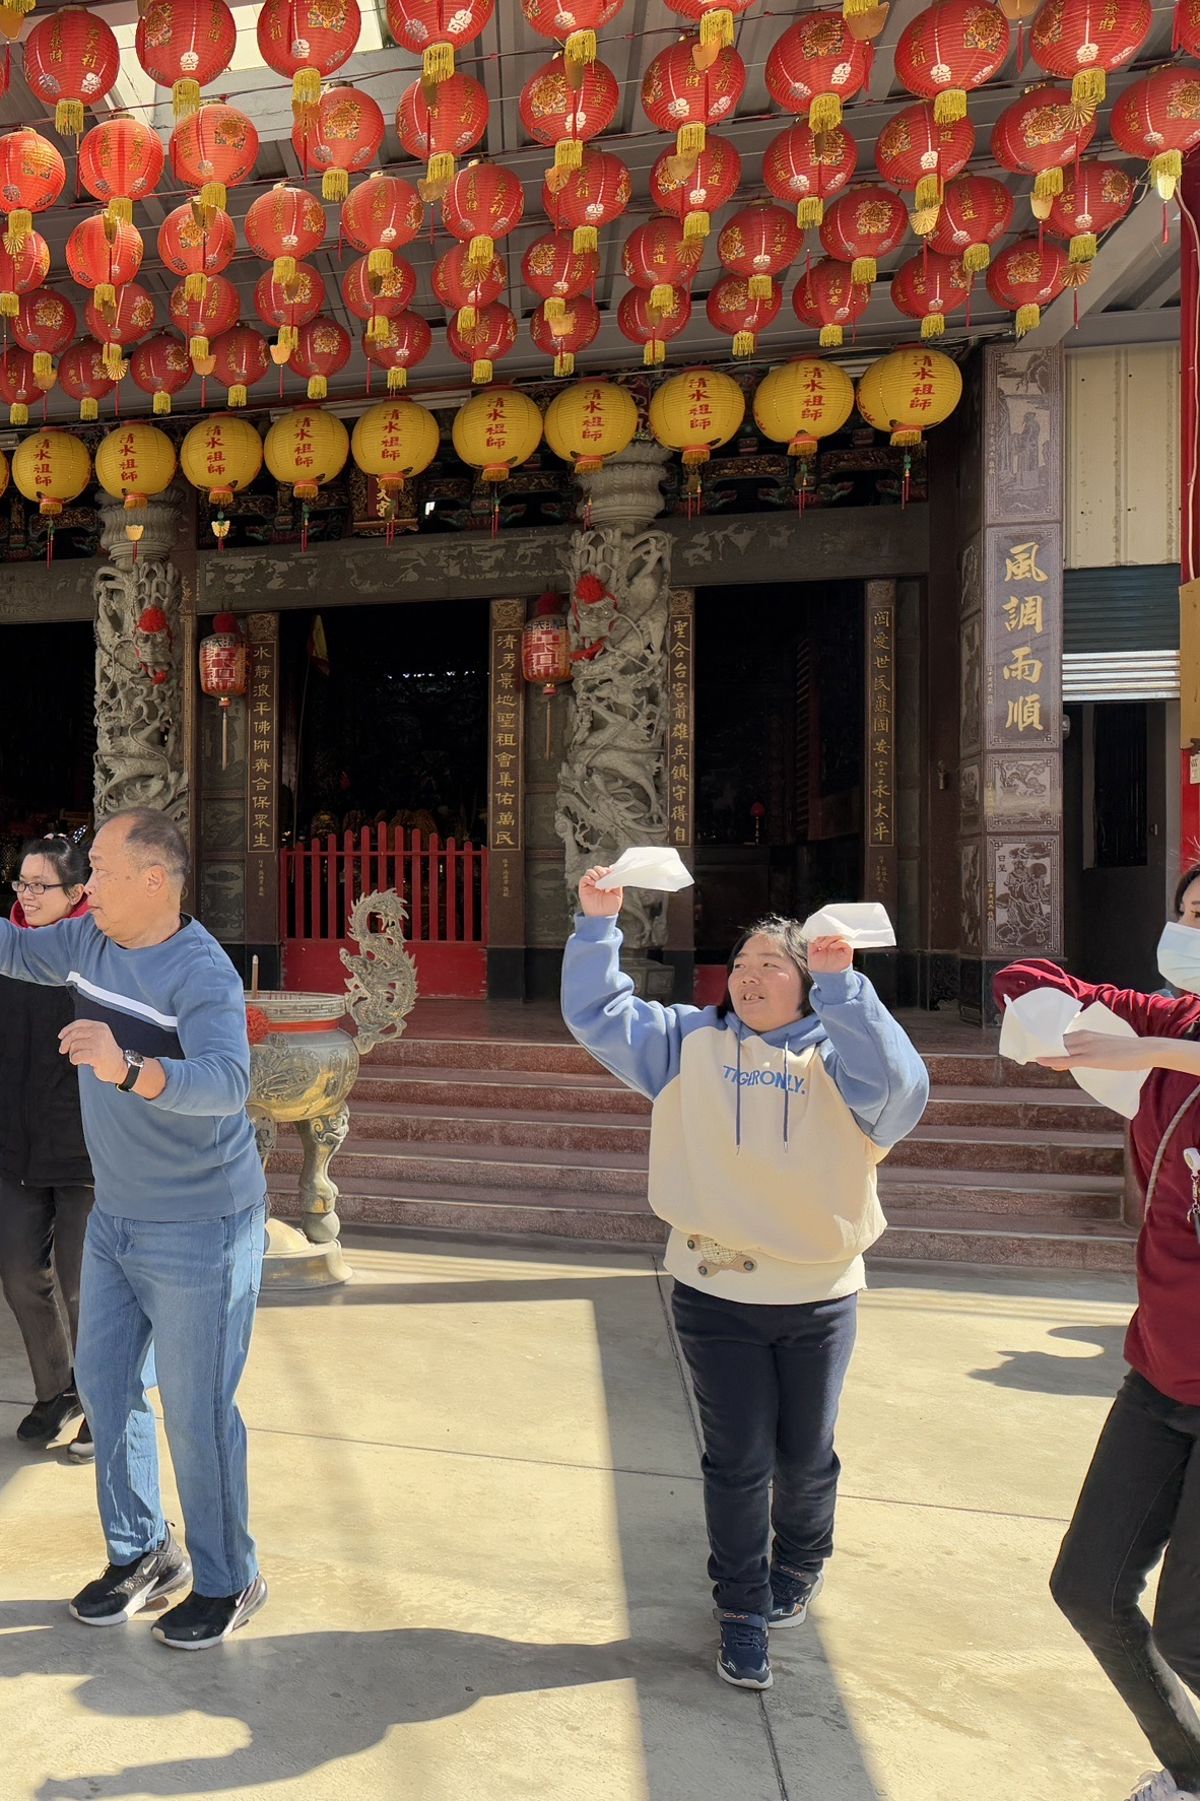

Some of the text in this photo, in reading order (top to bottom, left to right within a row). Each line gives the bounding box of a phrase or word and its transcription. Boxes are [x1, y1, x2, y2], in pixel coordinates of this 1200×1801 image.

[688, 377, 712, 430] 清水祖師
[801, 367, 825, 421] 清水祖師
[910, 355, 935, 410] 清水祖師
[381, 409, 402, 461] 清水祖師
[486, 397, 508, 449] 清水祖師
[582, 389, 605, 442] 清水祖師
[33, 439, 53, 487] 清水祖師
[119, 433, 139, 482] 清水祖師
[206, 424, 226, 475] 清水祖師
[295, 417, 314, 468] 清水祖師
[1001, 541, 1048, 732] 風調雨順
